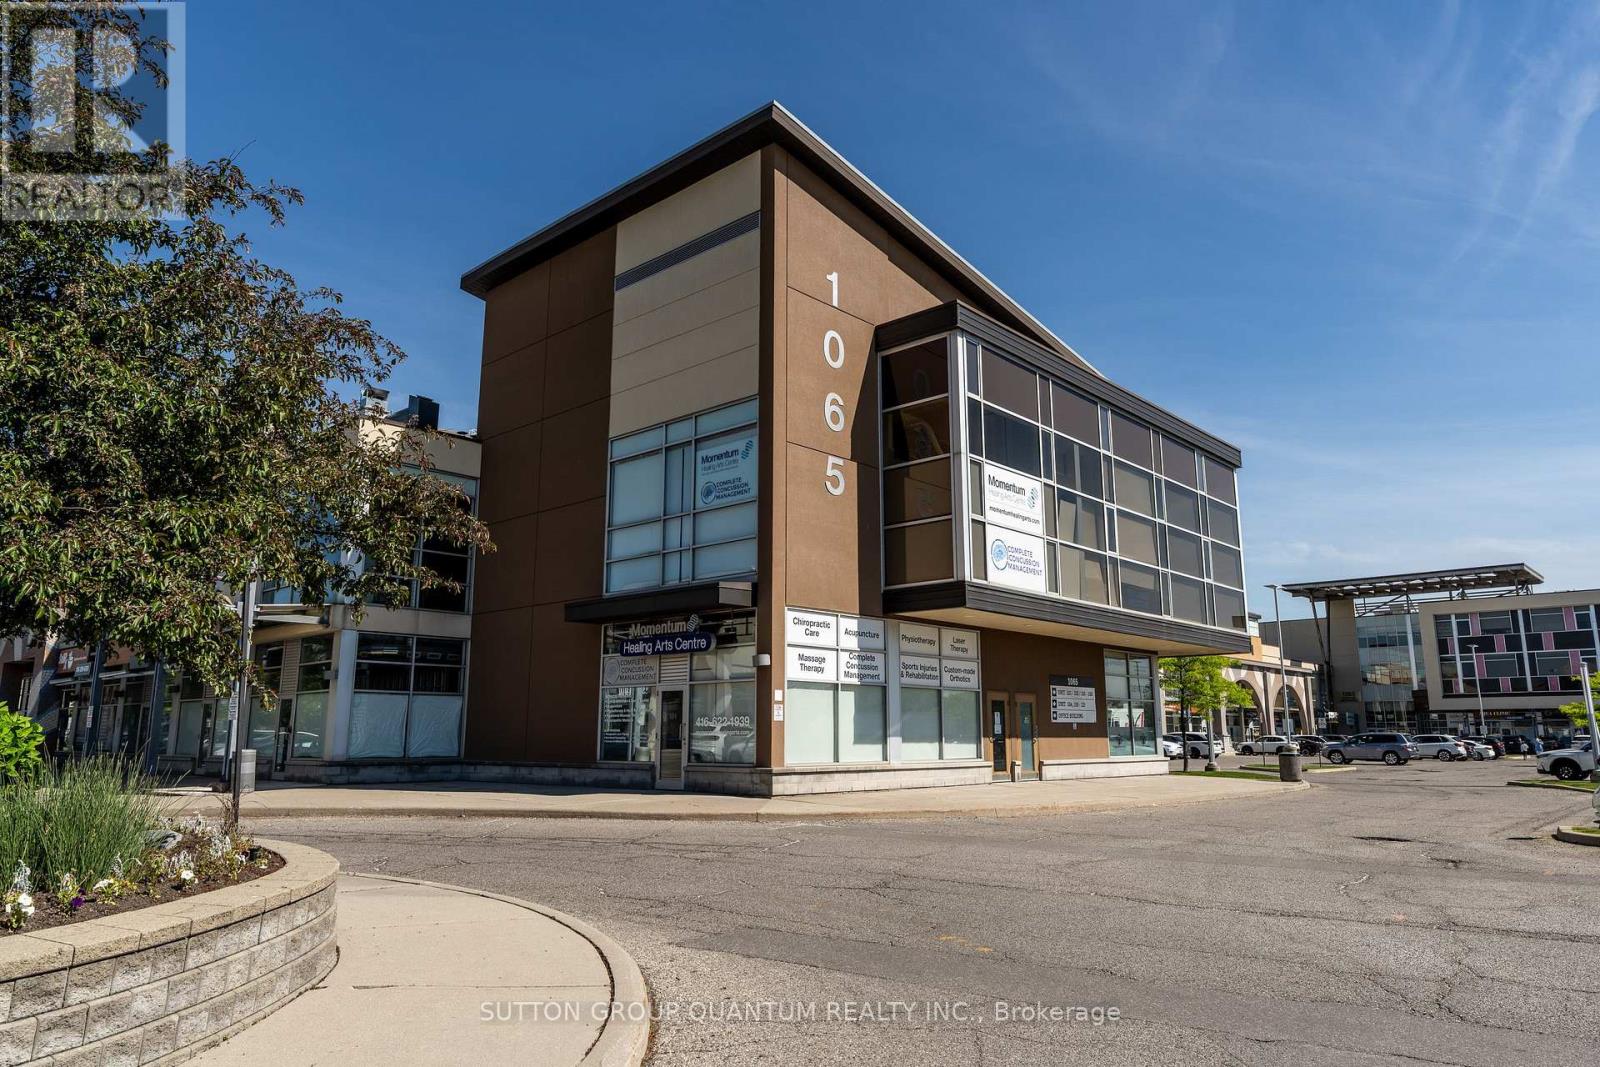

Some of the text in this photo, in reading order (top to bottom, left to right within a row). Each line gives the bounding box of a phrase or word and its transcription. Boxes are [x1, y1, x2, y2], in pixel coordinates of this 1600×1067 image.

[823, 271, 845, 496] 1065
[701, 449, 739, 465] Momentum
[988, 474, 1026, 497] Momentum
[1007, 545, 1033, 558] COMPLETE
[1008, 554, 1040, 568] CONCUSSION
[1007, 563, 1042, 576] MANAGEMENT
[792, 616, 831, 629] Chiropractic
[630, 620, 687, 637] Momentum
[804, 628, 820, 637] Care
[844, 627, 880, 640] Acupuncture
[623, 637, 707, 654] Healing Arts Centre
[901, 634, 936, 646] Physiotherapy
[952, 636, 966, 644] Laser
[950, 644, 969, 654] Therapy
[797, 653, 826, 664] Massage
[848, 652, 876, 663] Complete
[799, 663, 825, 674] Therapy
[845, 661, 879, 671] Concussion
[901, 661, 938, 672] Sports Injuries
[944, 665, 976, 675] Custom-made
[843, 670, 881, 681] Management
[905, 671, 939, 681] Rehabilitation
[949, 674, 971, 683] Orthotics
[695, 716, 750, 727] 416-622-1939
